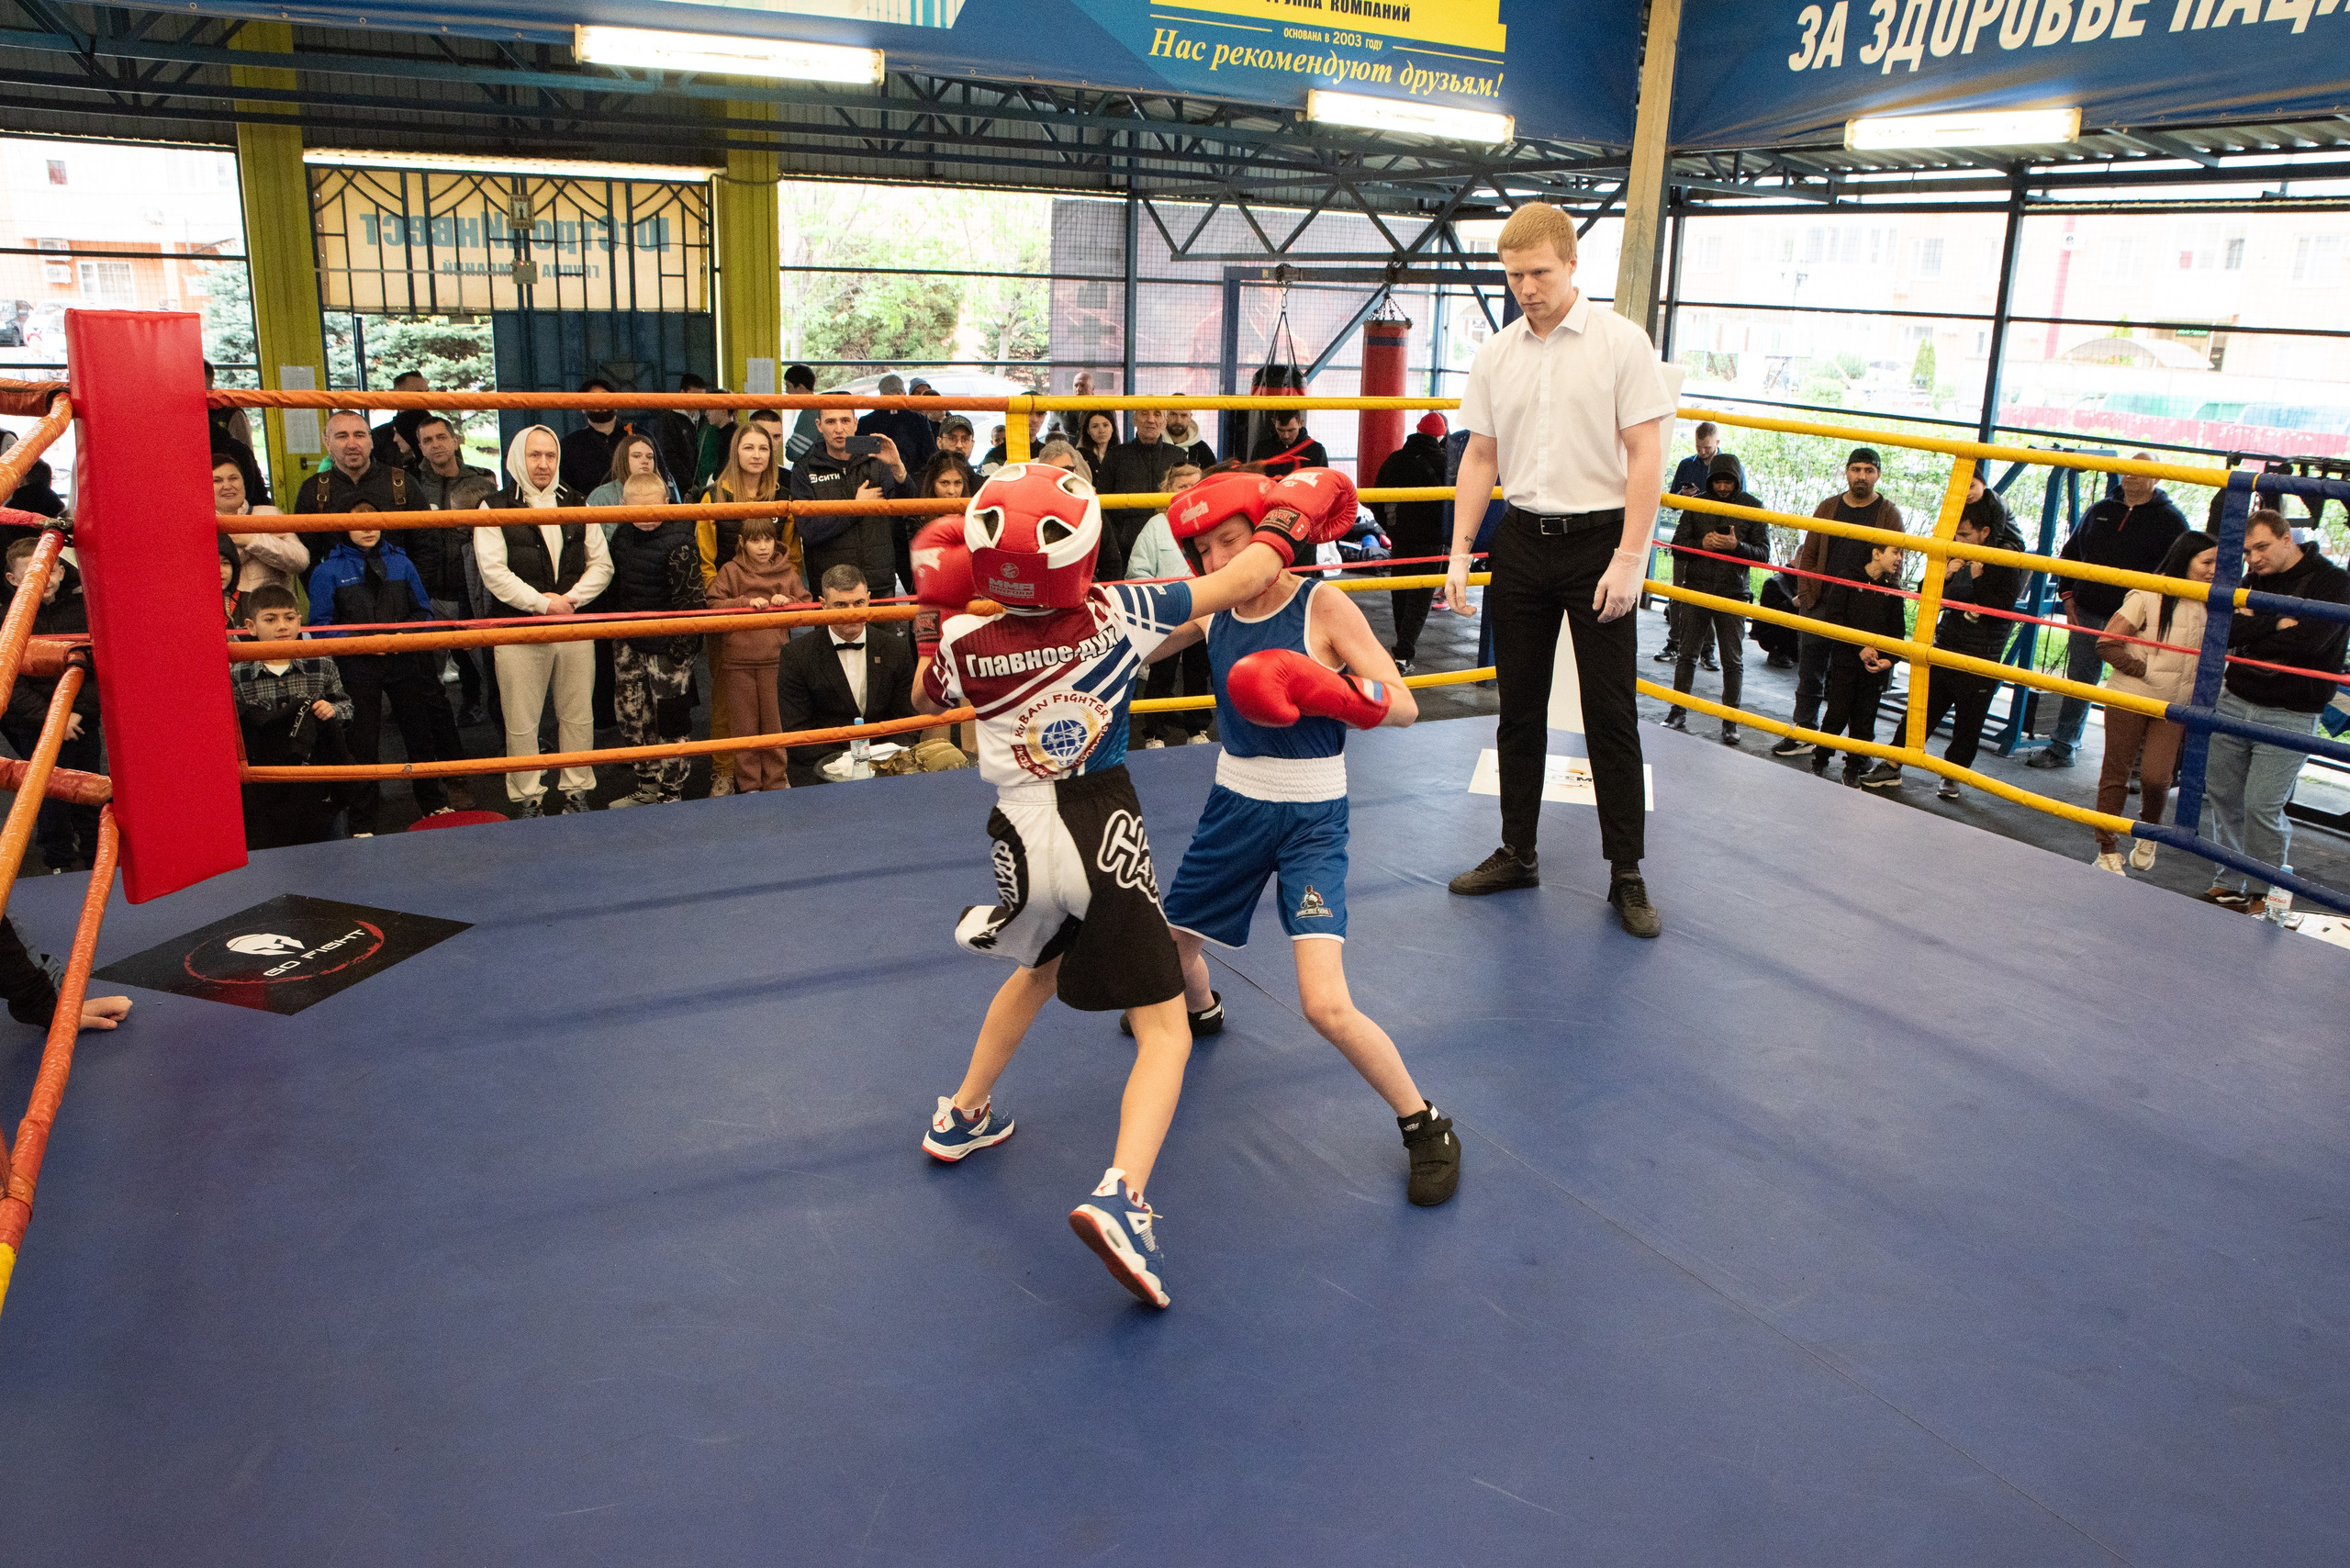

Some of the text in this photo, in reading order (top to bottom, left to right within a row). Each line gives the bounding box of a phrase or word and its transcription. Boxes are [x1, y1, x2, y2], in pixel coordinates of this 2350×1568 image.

[1330, 0, 1411, 23] КОМПАНИЙ
[1283, 27, 1322, 42] ОСНОВАНА
[1332, 31, 1362, 47] 2003
[1787, 3, 1849, 73] ЗА
[1148, 27, 1505, 98] Нас рекомендуют друзьям!
[819, 473, 841, 482] СИТИ
[989, 577, 1035, 591] MMA
[263, 929, 365, 977] GO FIGHT
